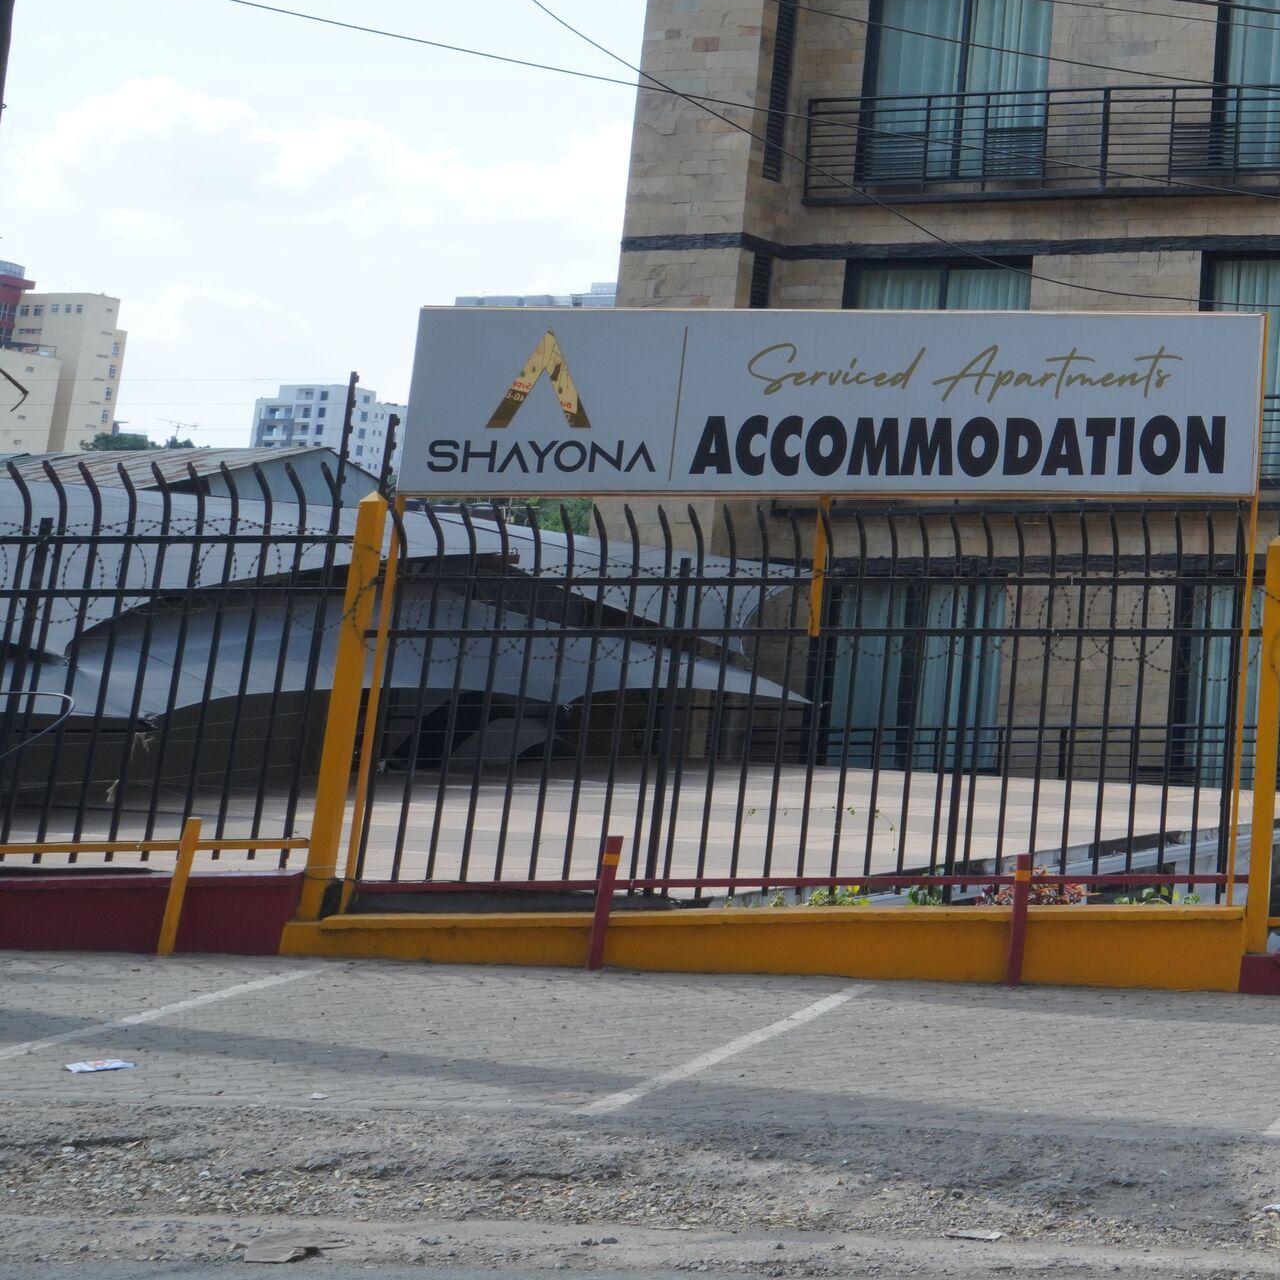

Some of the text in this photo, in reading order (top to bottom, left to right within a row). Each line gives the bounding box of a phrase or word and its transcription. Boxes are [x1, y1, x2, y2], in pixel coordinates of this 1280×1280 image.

[748, 342, 1184, 403] Serviced Apartments
[427, 440, 656, 473] SHAYONA
[689, 415, 1226, 477] ACCOMMODATION
